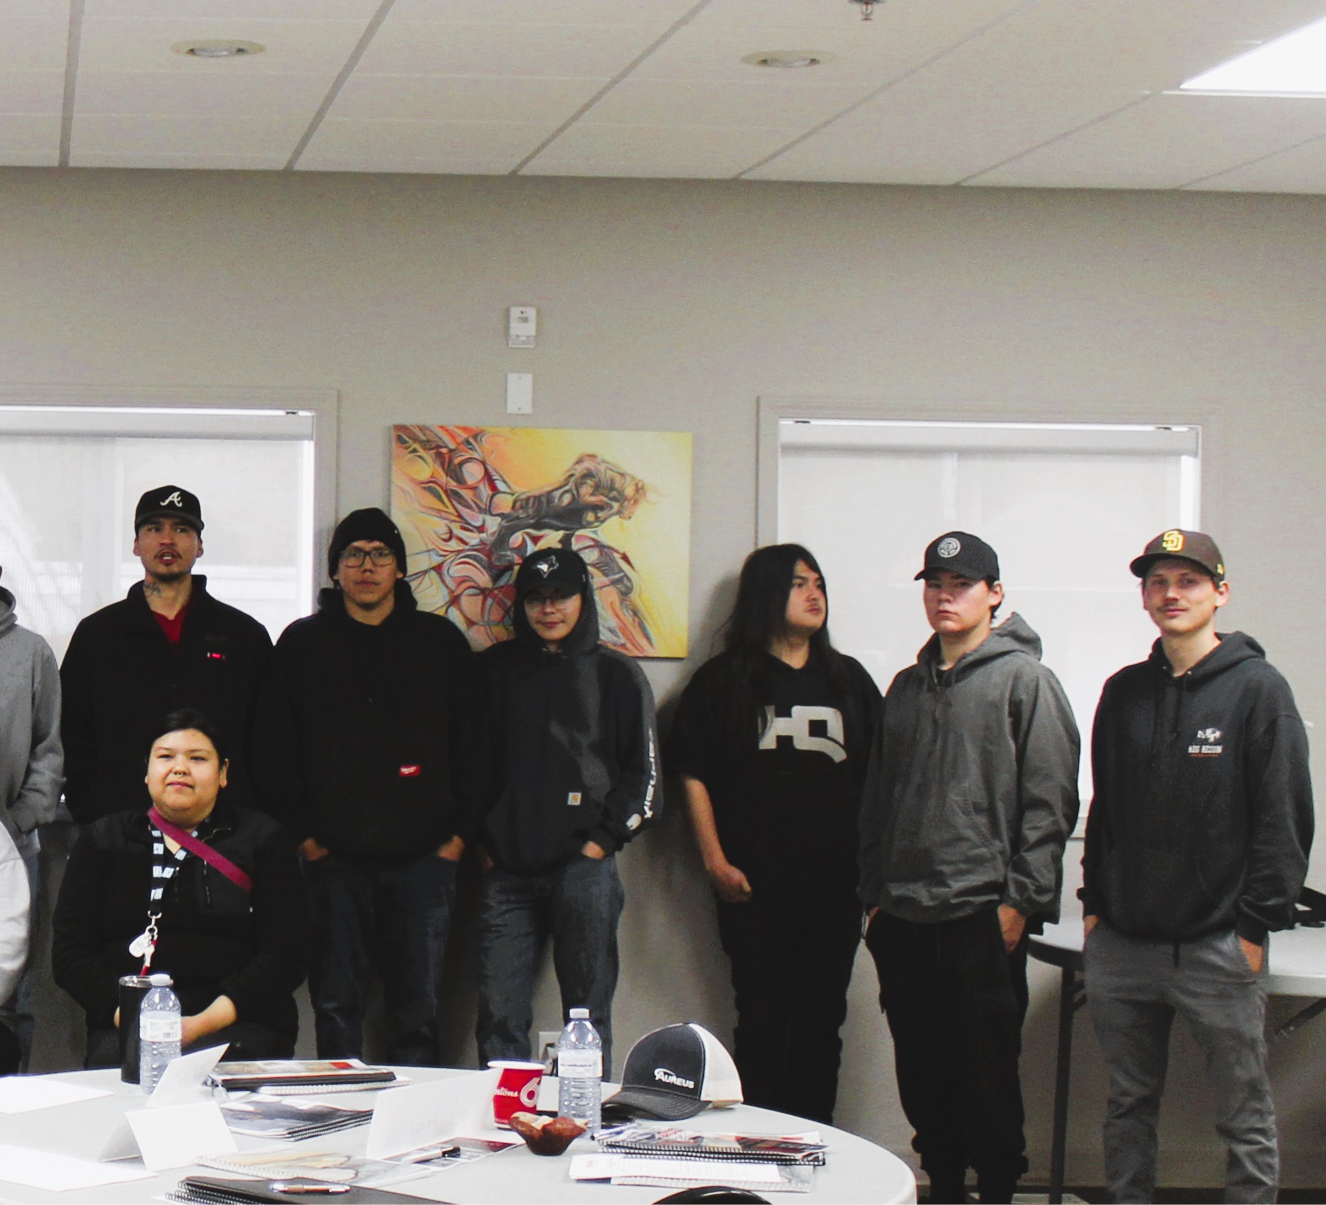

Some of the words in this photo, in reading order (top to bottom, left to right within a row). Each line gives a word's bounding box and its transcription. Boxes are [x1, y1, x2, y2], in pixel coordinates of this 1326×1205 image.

[160, 491, 182, 507] A
[1162, 530, 1185, 552] SD
[758, 705, 847, 763] HQ
[654, 1068, 695, 1089] AUREUS
